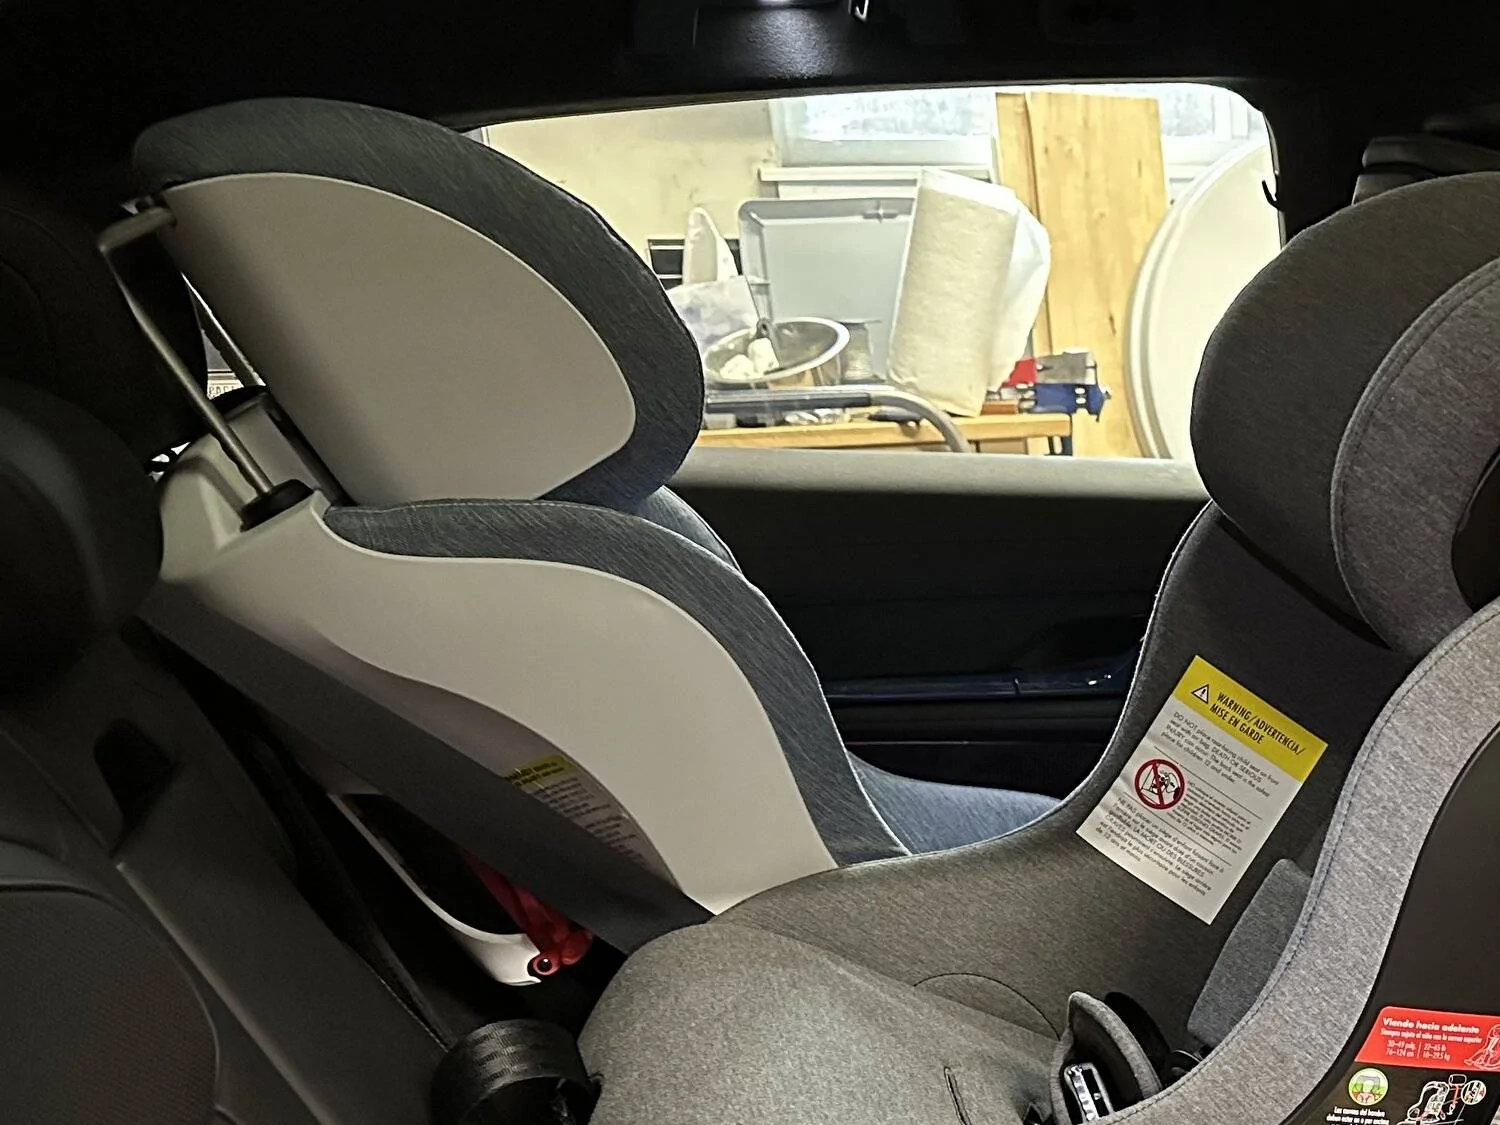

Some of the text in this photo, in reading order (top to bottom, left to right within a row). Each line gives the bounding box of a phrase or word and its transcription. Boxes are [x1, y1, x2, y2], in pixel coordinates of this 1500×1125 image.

[1209, 703, 1263, 743] MISE EN GARDE
